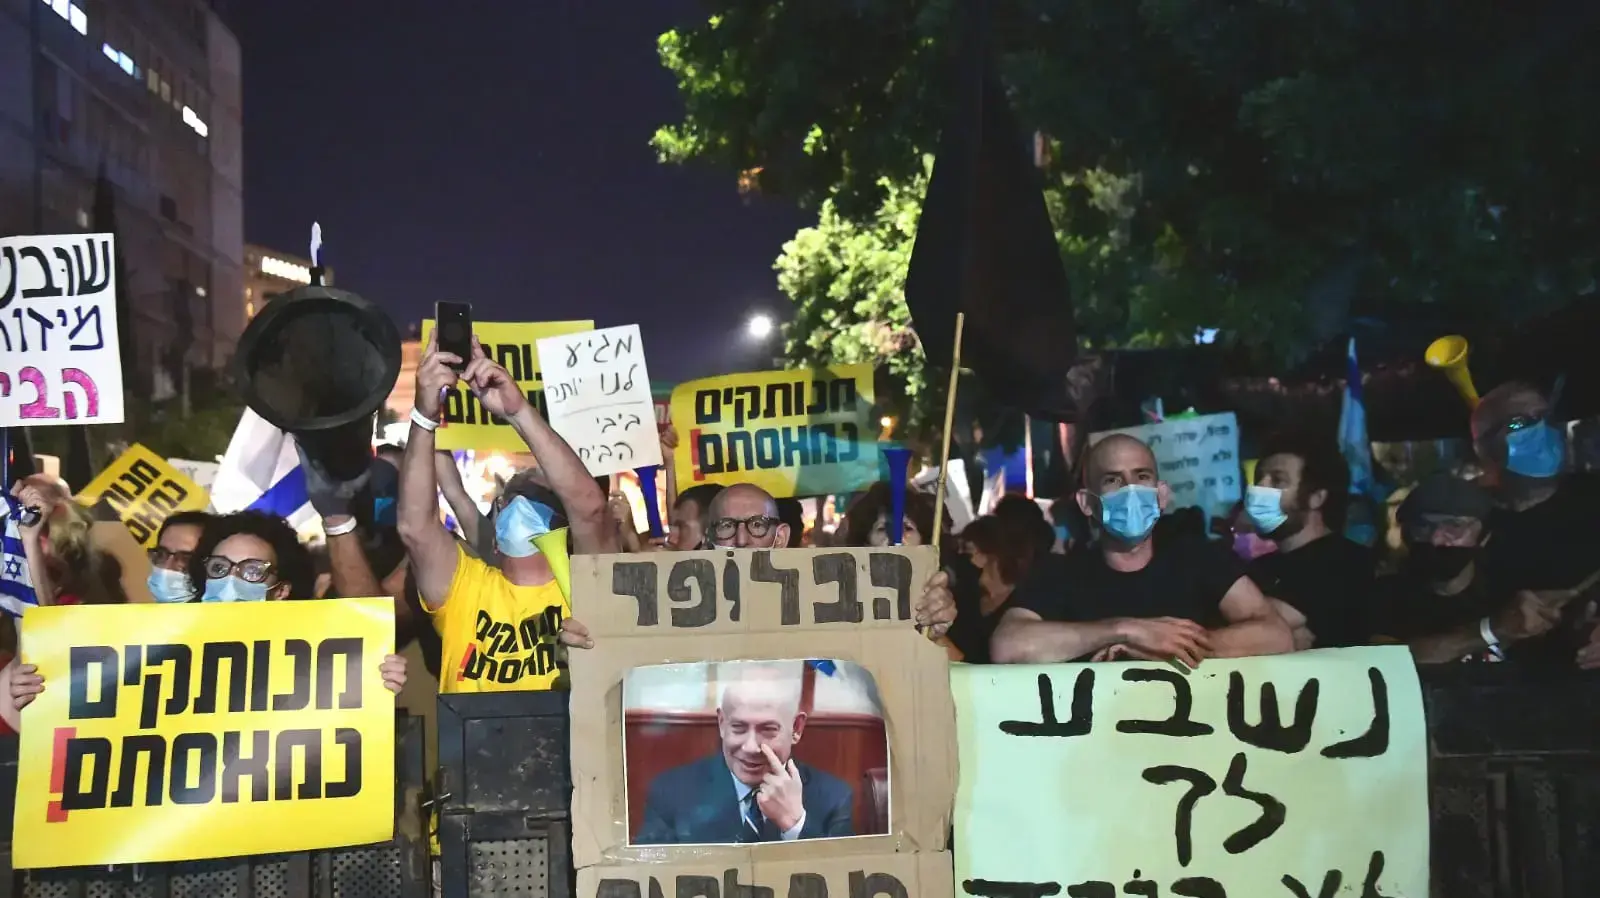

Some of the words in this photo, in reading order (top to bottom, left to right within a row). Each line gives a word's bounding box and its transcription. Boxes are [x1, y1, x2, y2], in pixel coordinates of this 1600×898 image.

[565, 333, 633, 369] מגיע
[547, 377, 582, 403] יותר
[601, 363, 638, 396] לנו
[695, 378, 857, 428] מנותקים
[596, 413, 641, 434] ביבי
[690, 422, 860, 481] נמאסתם!
[68, 637, 364, 729] מנותקים
[999, 667, 1390, 758] נשבע
[46, 727, 363, 823] נמאסתם!
[1141, 752, 1287, 867] לך
